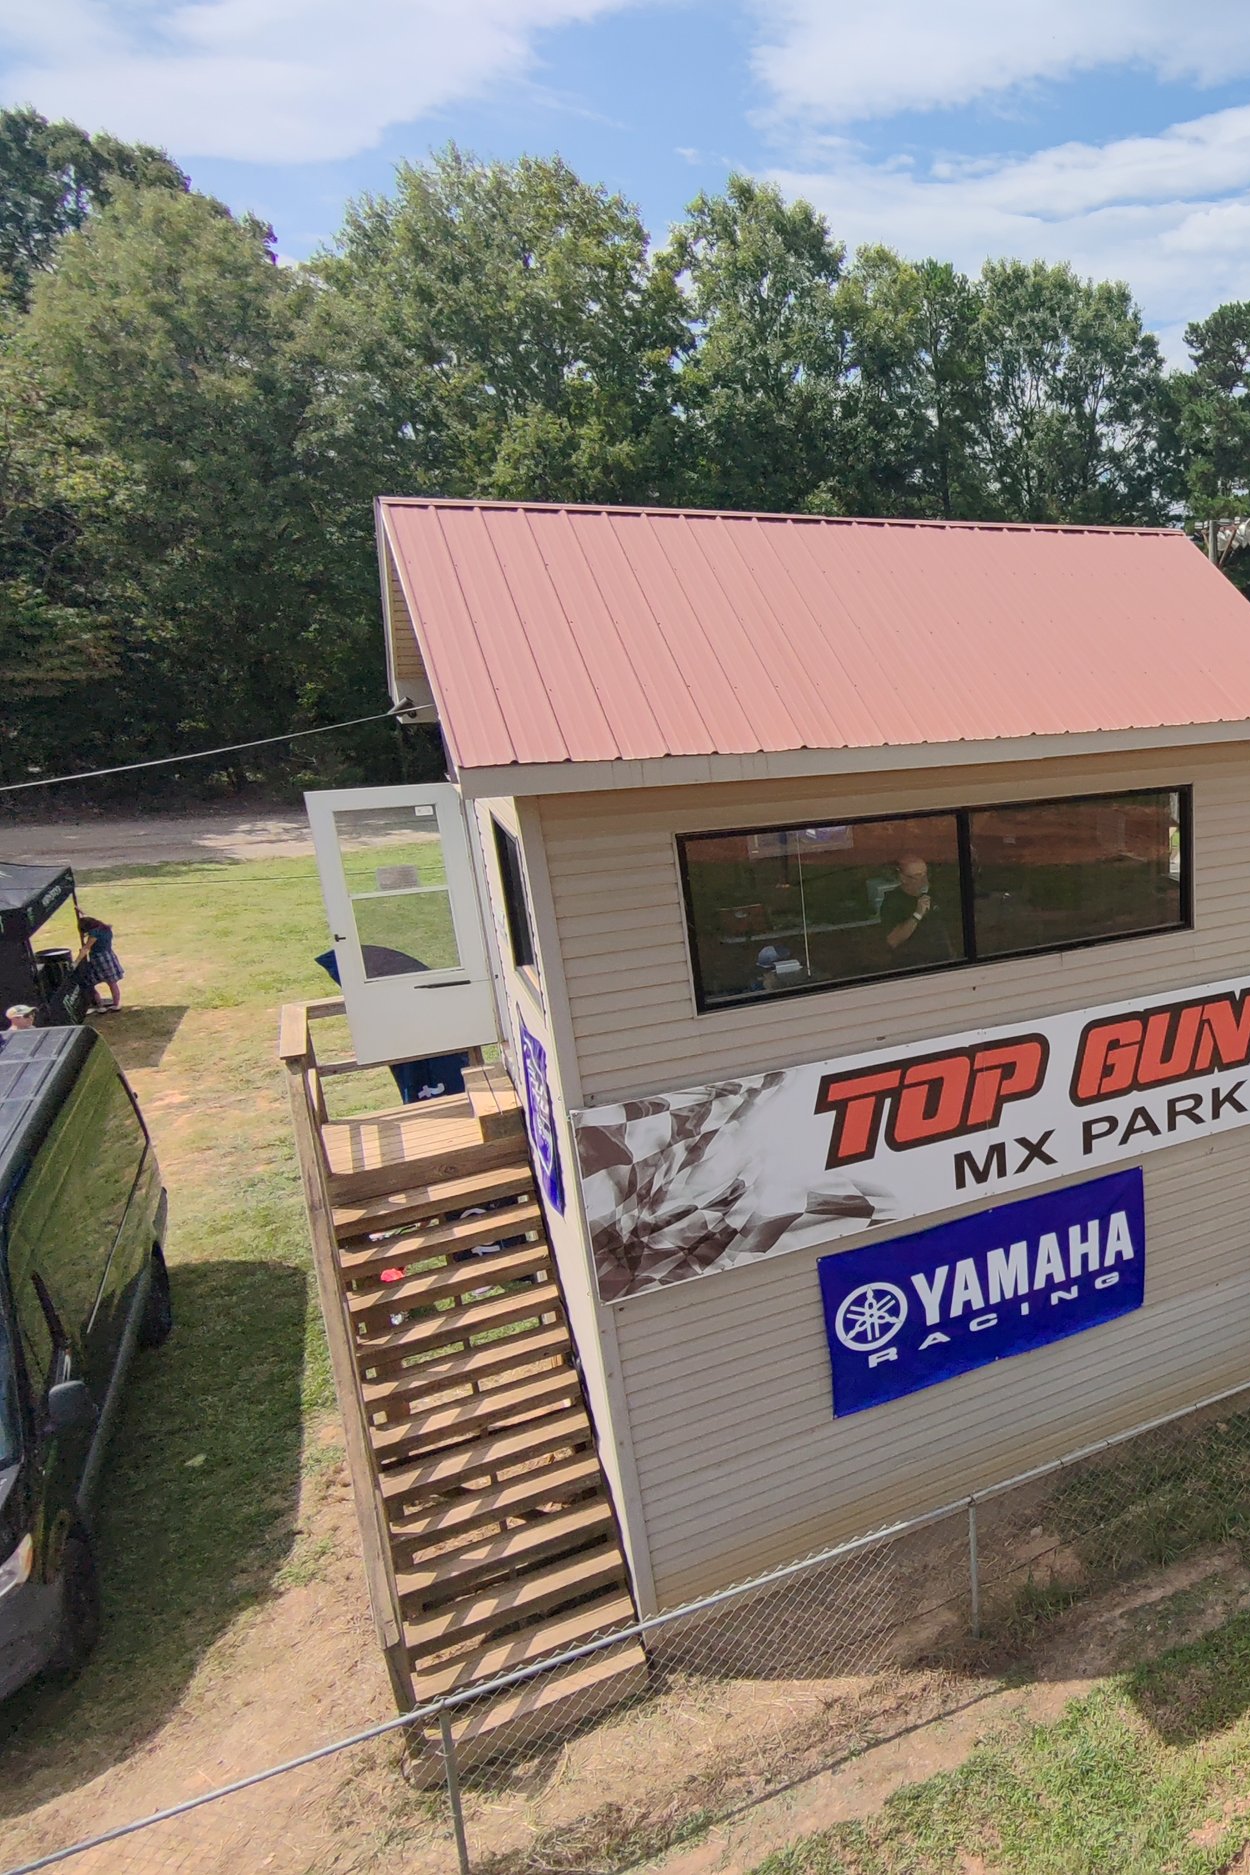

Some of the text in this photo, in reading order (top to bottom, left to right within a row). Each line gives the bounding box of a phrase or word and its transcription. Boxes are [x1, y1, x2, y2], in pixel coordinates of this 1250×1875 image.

[814, 1033, 1050, 1170] TOP
[954, 1079, 1248, 1190] MX PARK
[868, 1272, 1119, 1368] RACING
[911, 1210, 1134, 1326] YAMAHA
